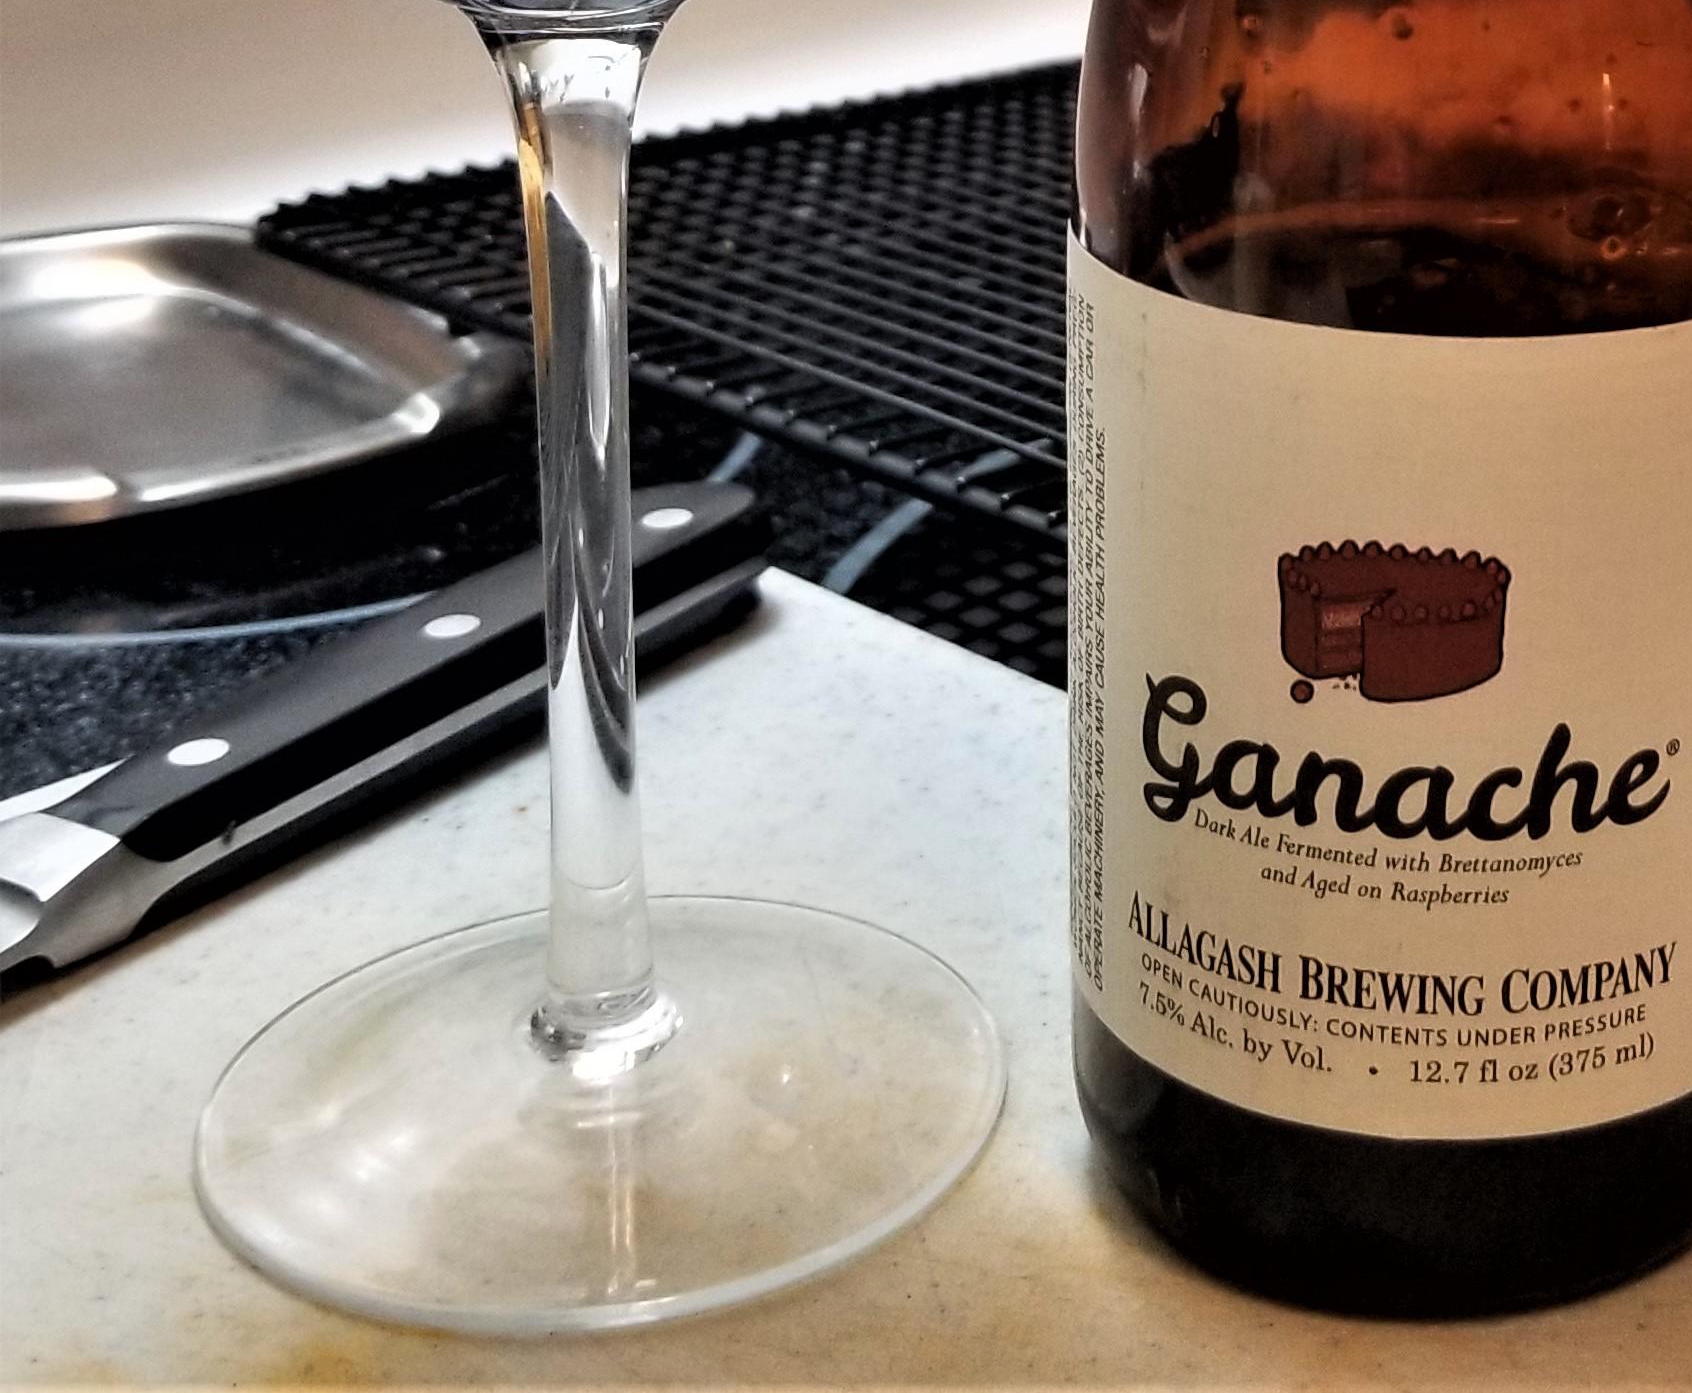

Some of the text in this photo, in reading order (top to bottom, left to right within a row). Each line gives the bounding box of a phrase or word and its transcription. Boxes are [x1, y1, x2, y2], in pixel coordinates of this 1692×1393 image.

[1086, 302, 1094, 333] OR
[1086, 341, 1094, 381] CAR
[1086, 406, 1094, 465] DRIVE
[1086, 470, 1094, 495] TO
[1086, 504, 1094, 578] ABILITY
[1085, 578, 1093, 632] YOUR
[1085, 637, 1093, 718] IMPAIRS
[1094, 428, 1105, 991] OPERATE MACHINERY, AND MAY CAUSE HEALTH PROBLEMS.
[1084, 721, 1092, 836] BEVERAGES
[1195, 808, 1583, 878] Dark Ale Fermented with Brettanomyces
[1084, 838, 1092, 944] ALCOHOLIC
[1261, 866, 1510, 911] and Aged on Raspberries
[1128, 890, 1677, 1016] ALLAGASH BREWING COMPANY
[1139, 981, 1654, 1084] 7.5% Alc. by Vol. 12.7 fl oz (375 ml)
[1142, 953, 1646, 1047] OPEN CAUTIOUSLY: CONTENTS UNDER PRESSURE
